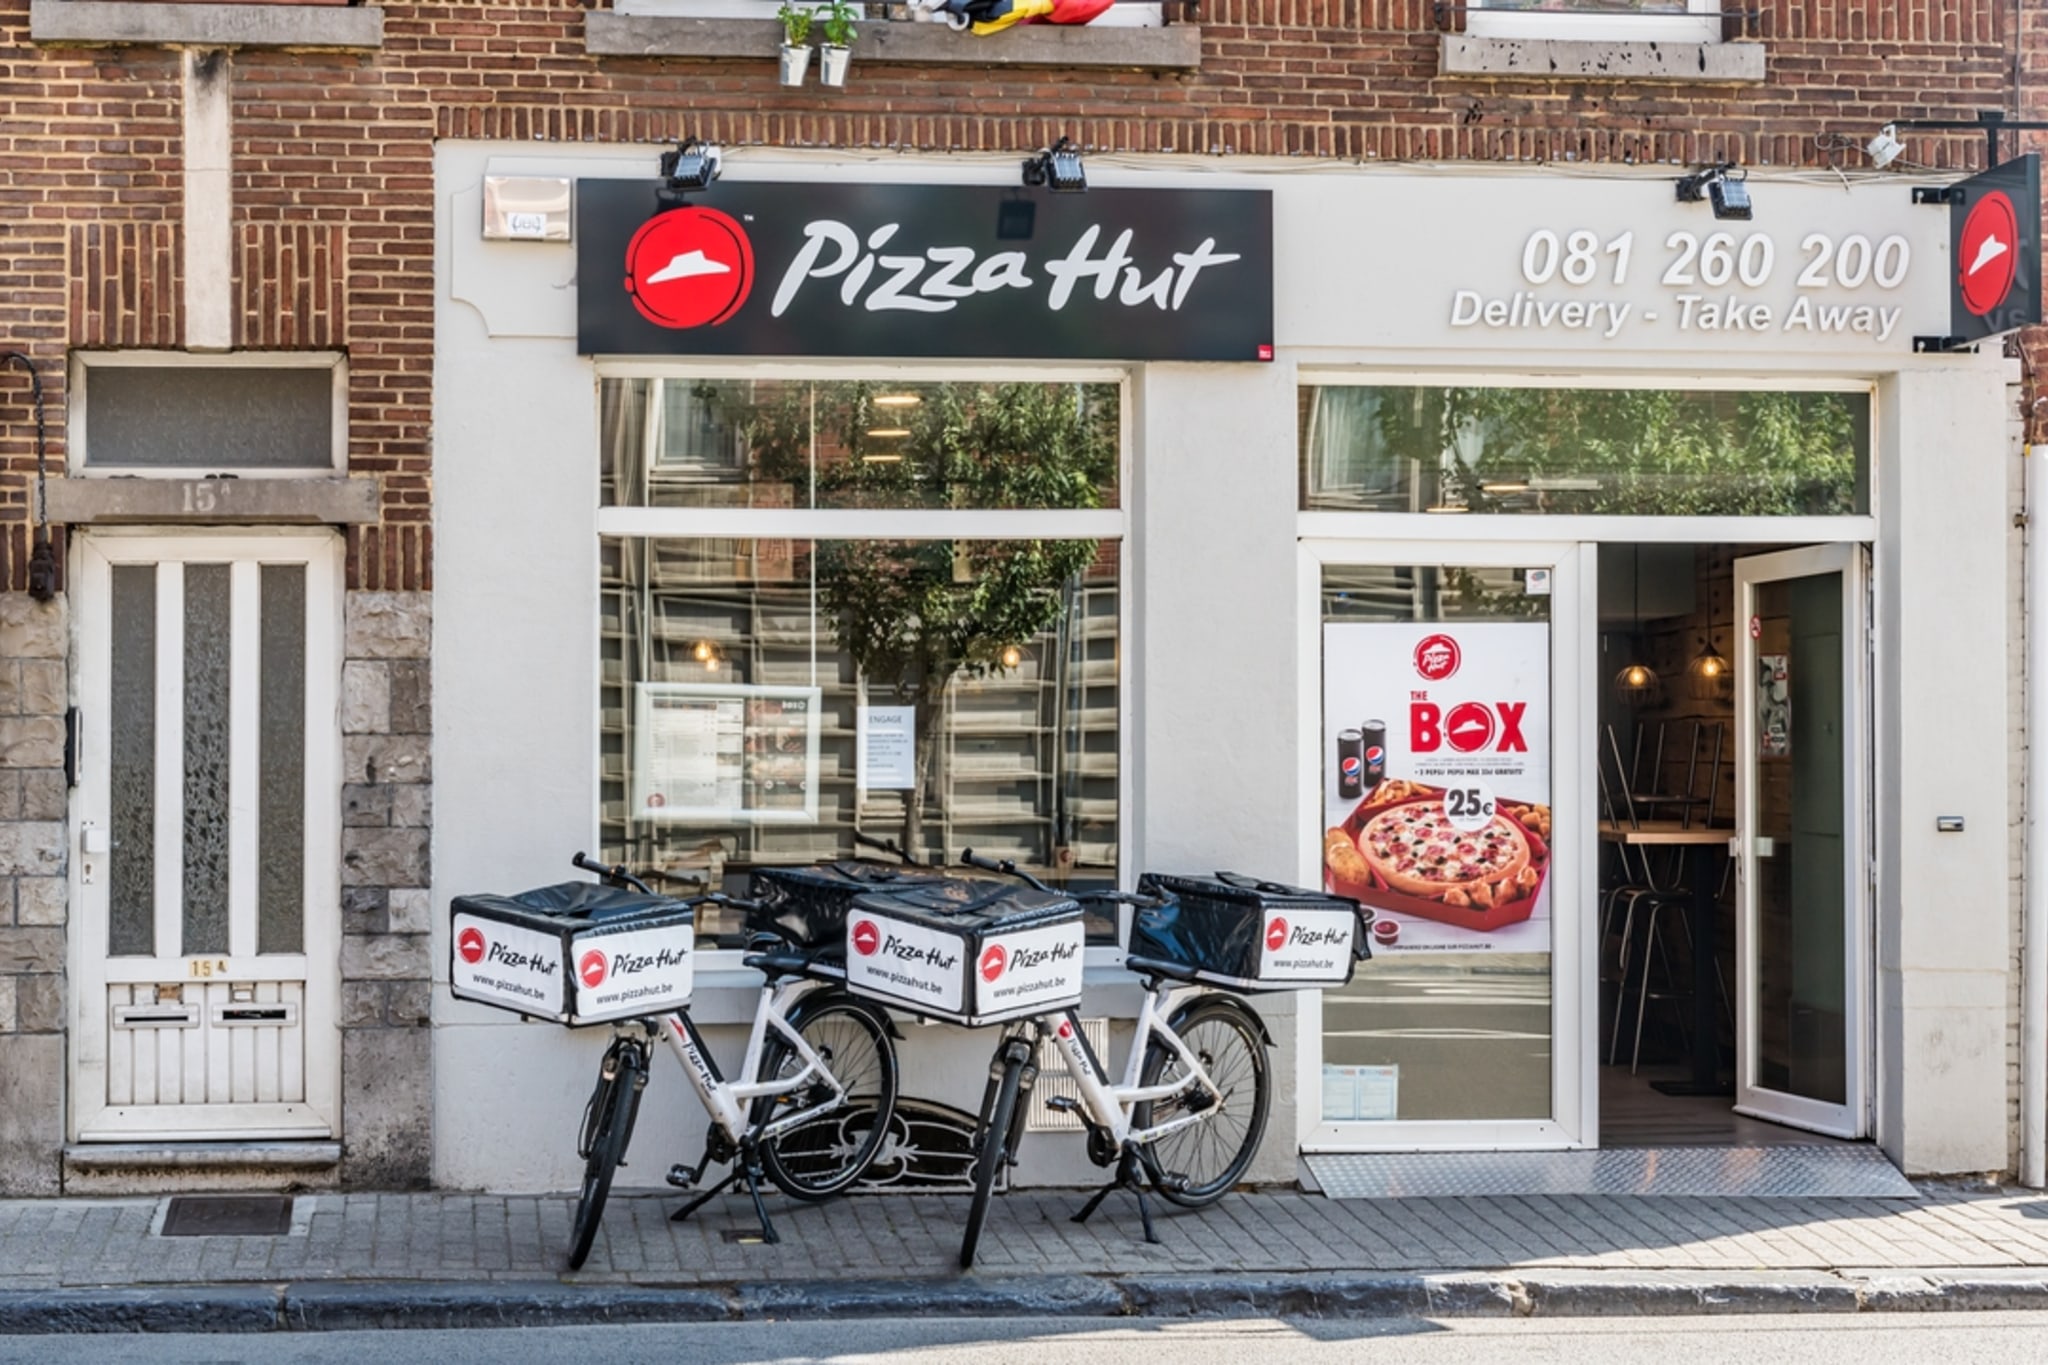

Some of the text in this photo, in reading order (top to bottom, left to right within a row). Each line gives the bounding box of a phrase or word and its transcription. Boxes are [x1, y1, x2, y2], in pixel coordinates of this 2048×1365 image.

[771, 219, 1241, 318] Pizza Hut
[1522, 229, 1910, 288] 081 260 200
[1451, 290, 1631, 338] Delivery
[1676, 294, 1772, 331] Take
[1783, 295, 1902, 341] Away
[1411, 691, 1428, 701] THE
[1411, 702, 1528, 753] BOX
[1289, 926, 1349, 946] Pizza Hut
[488, 940, 558, 976] Pizza Hut
[611, 948, 688, 977] Pizza Hut
[882, 934, 958, 971] Pizza Hut
[1009, 941, 1079, 972] Pizza Hut
[1273, 958, 1334, 969] www.pizzahut.be
[473, 974, 545, 1000] www.pizzahut.be
[596, 983, 673, 1005] www.pizzahut.be
[866, 965, 943, 995] www.pizzahut.be
[993, 976, 1066, 998] www.pizzahut.be
